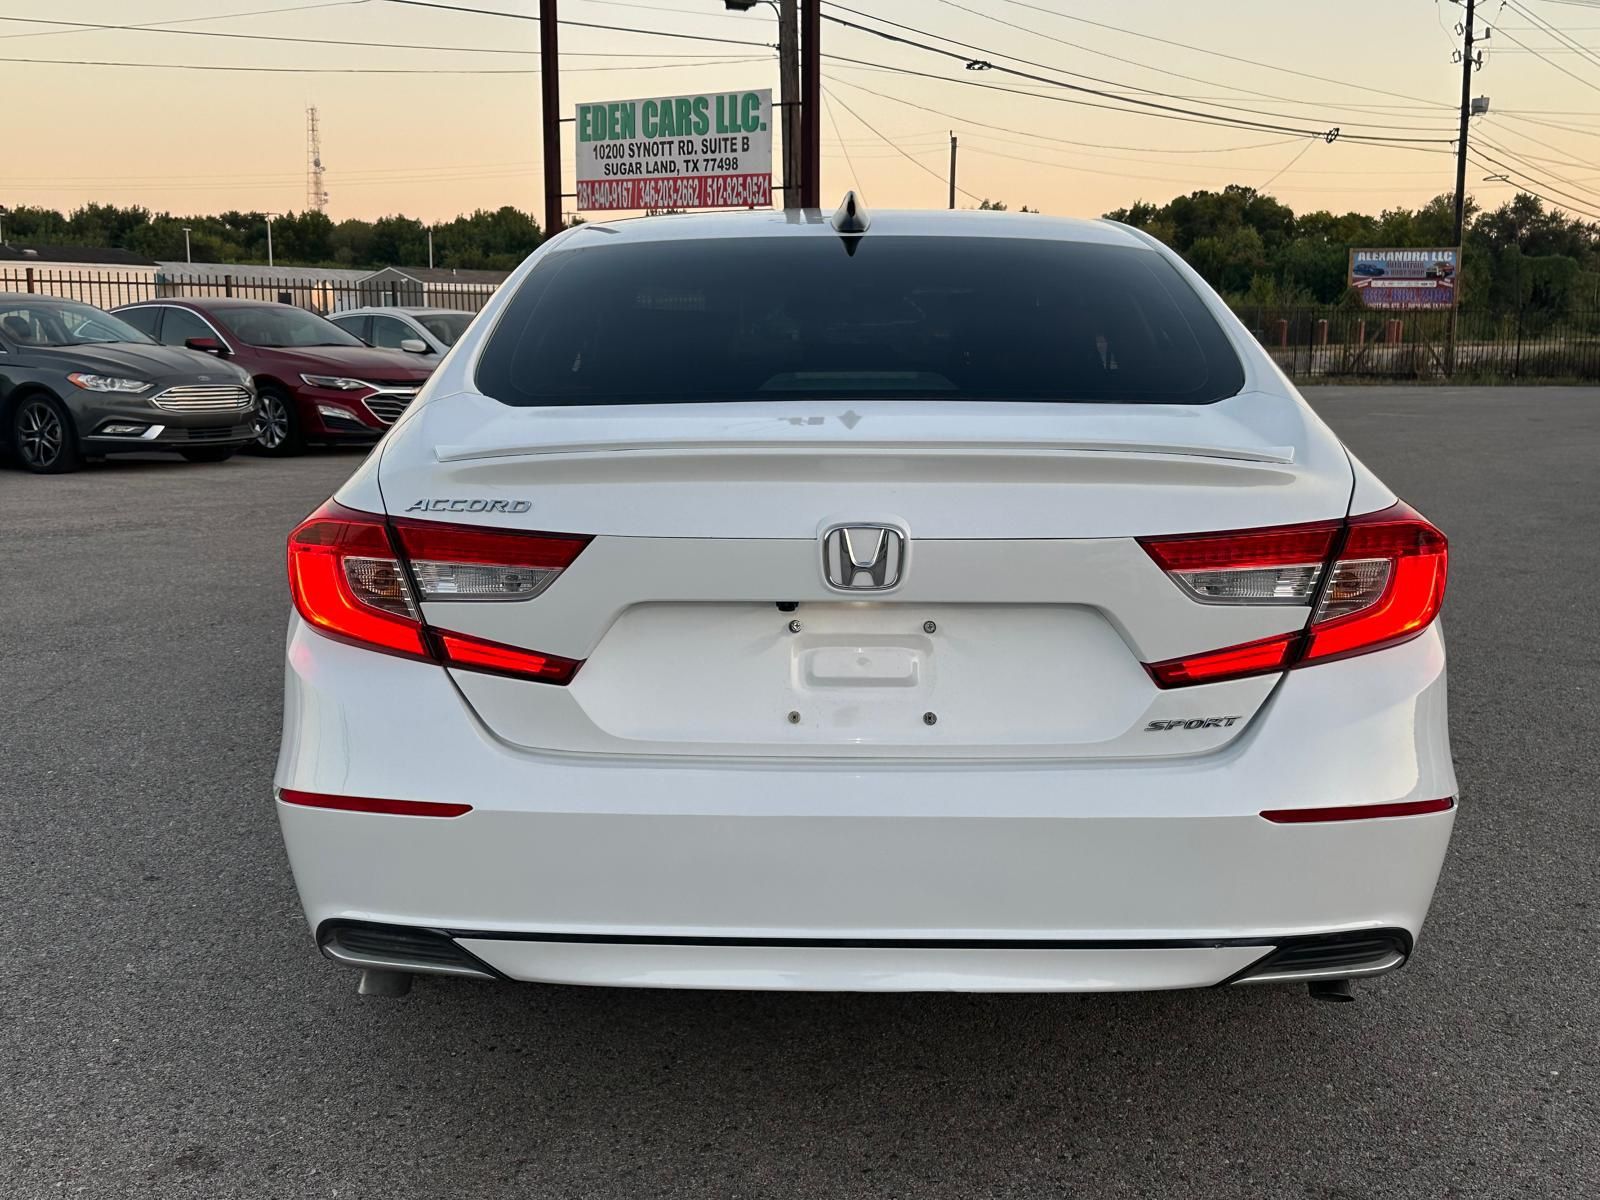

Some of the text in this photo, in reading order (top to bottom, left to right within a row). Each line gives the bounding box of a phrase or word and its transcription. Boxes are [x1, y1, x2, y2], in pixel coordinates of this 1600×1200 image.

[579, 92, 767, 142] EDEN CARS LLC.
[593, 136, 750, 160] 10200 SYNOTT RD. SUITE B
[604, 157, 738, 176] SUGAR LAND, TX 77498
[640, 177, 699, 208] 346-203-2662
[706, 175, 769, 207] 512-825-0521
[1358, 251, 1453, 261] ALEXANDRA LLC
[404, 498, 532, 514] ACCORD
[1143, 715, 1243, 732] SPORT
